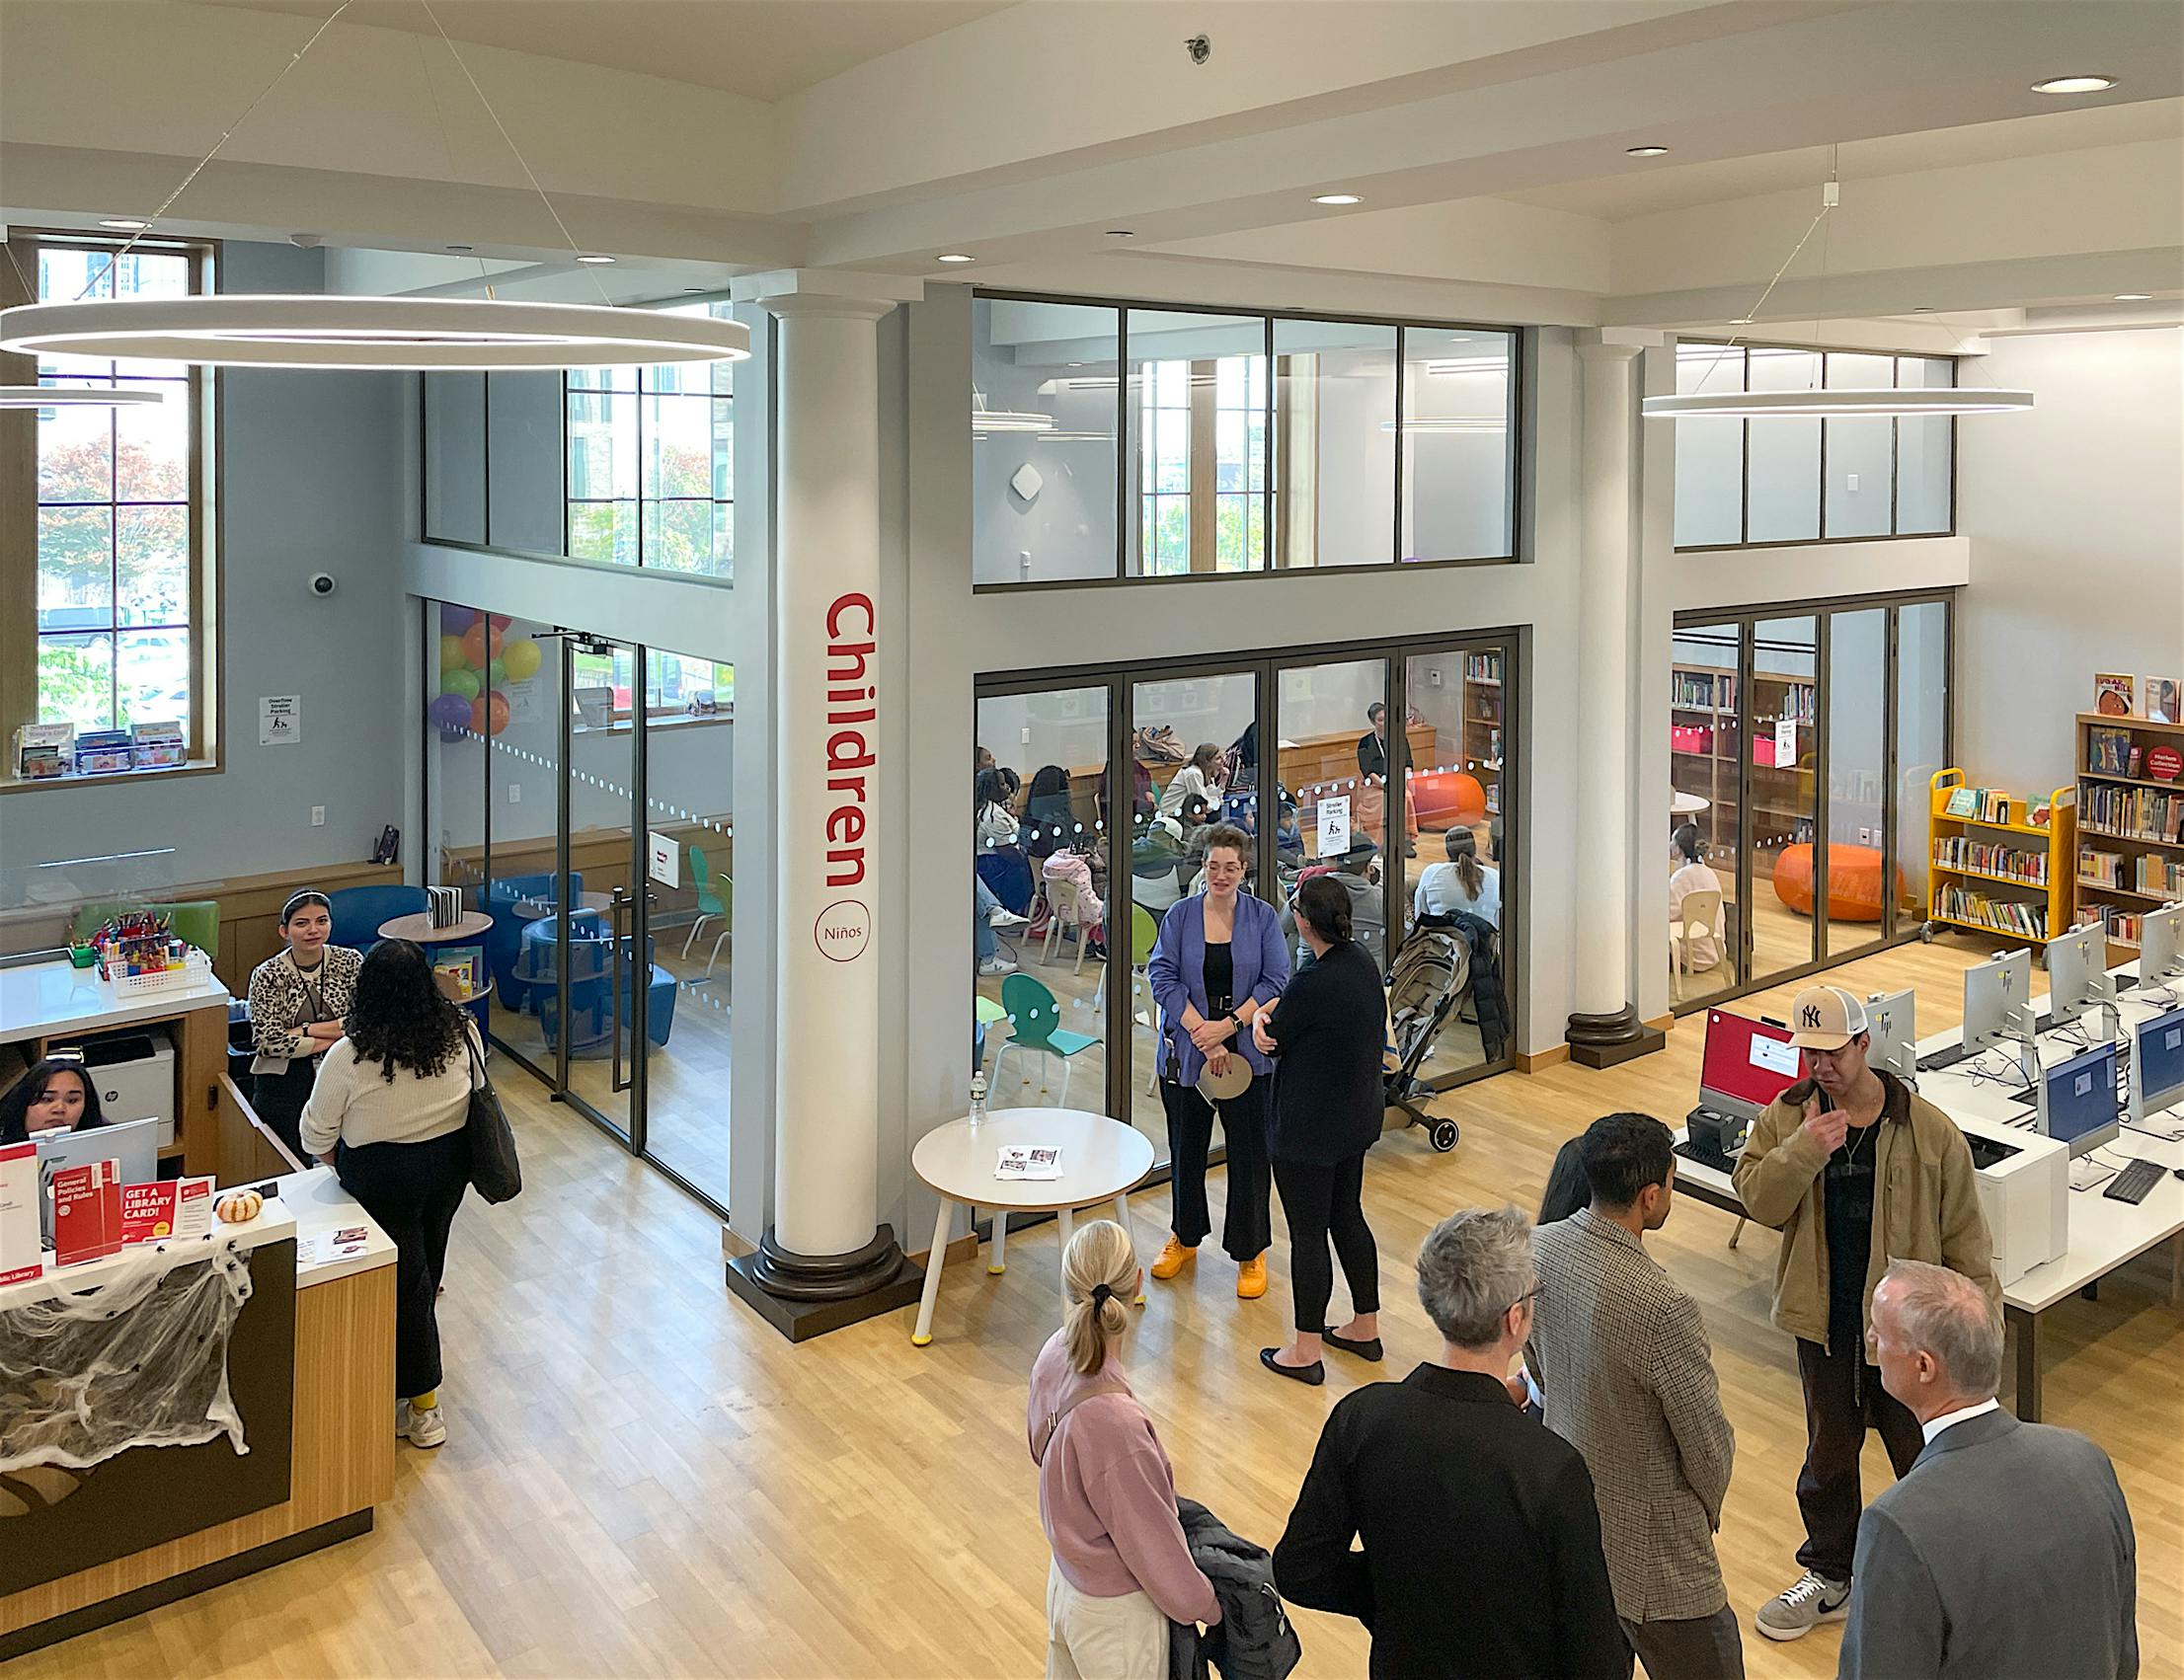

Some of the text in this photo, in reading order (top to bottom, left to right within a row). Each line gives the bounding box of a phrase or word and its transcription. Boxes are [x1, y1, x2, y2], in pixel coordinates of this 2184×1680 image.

[826, 592, 876, 887] Children
[824, 927, 862, 940] Niños
[1802, 1005, 1822, 1028] NY
[57, 1176, 87, 1188] General
[57, 1185, 86, 1196] Policies
[57, 1190, 94, 1203] and Rules
[125, 1187, 159, 1199] GET A
[125, 1196, 172, 1209] LIBRARY
[123, 1207, 160, 1219] CARD!
[11, 1269, 35, 1280] Library
